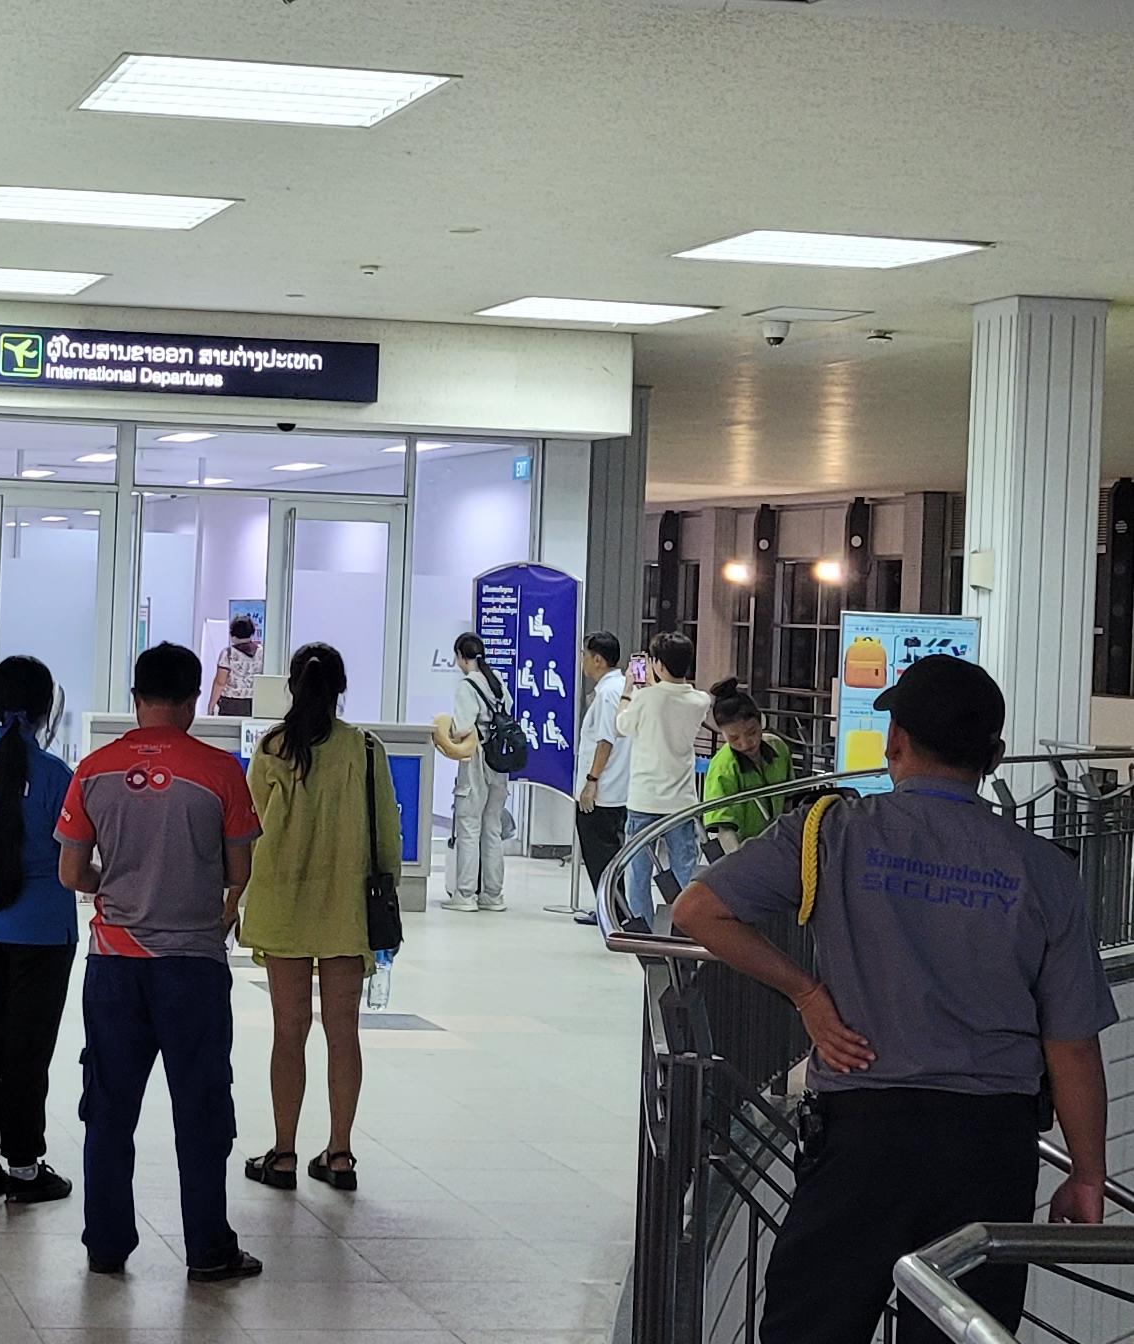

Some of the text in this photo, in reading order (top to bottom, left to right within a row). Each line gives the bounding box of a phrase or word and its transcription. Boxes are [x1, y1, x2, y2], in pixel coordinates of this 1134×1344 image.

[45, 363, 224, 387] International Departures
[860, 872, 1018, 913] SECURITY
